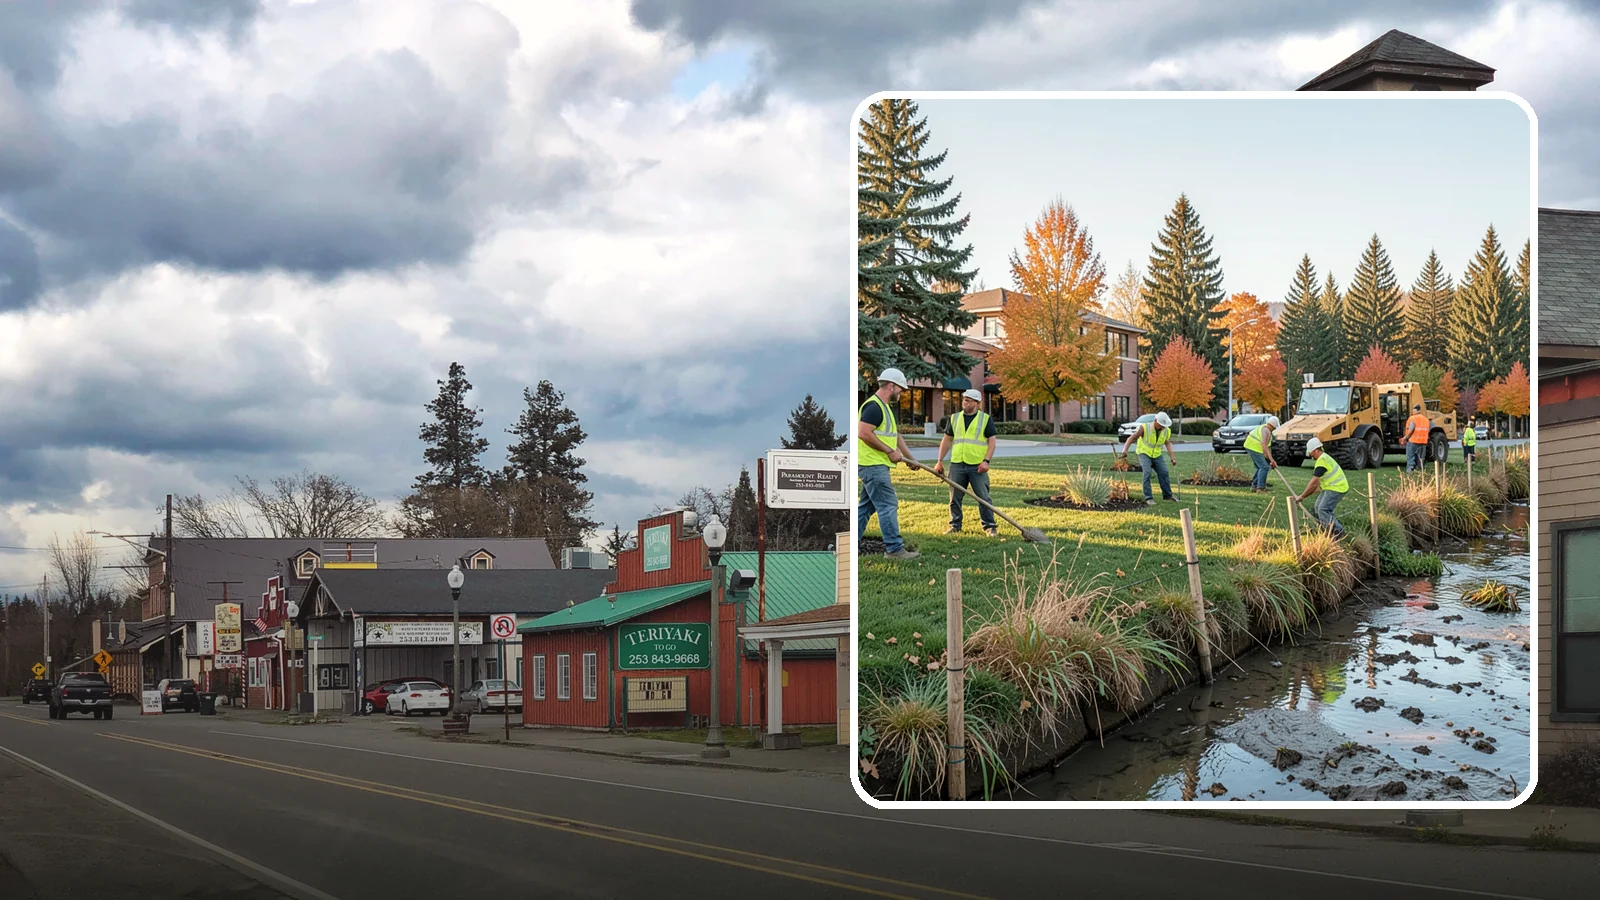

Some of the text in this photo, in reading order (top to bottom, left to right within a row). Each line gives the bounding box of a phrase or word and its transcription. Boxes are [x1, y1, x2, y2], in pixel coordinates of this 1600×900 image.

[625, 628, 702, 645] TERIYAKI
[629, 654, 700, 664] 253 843-9668
